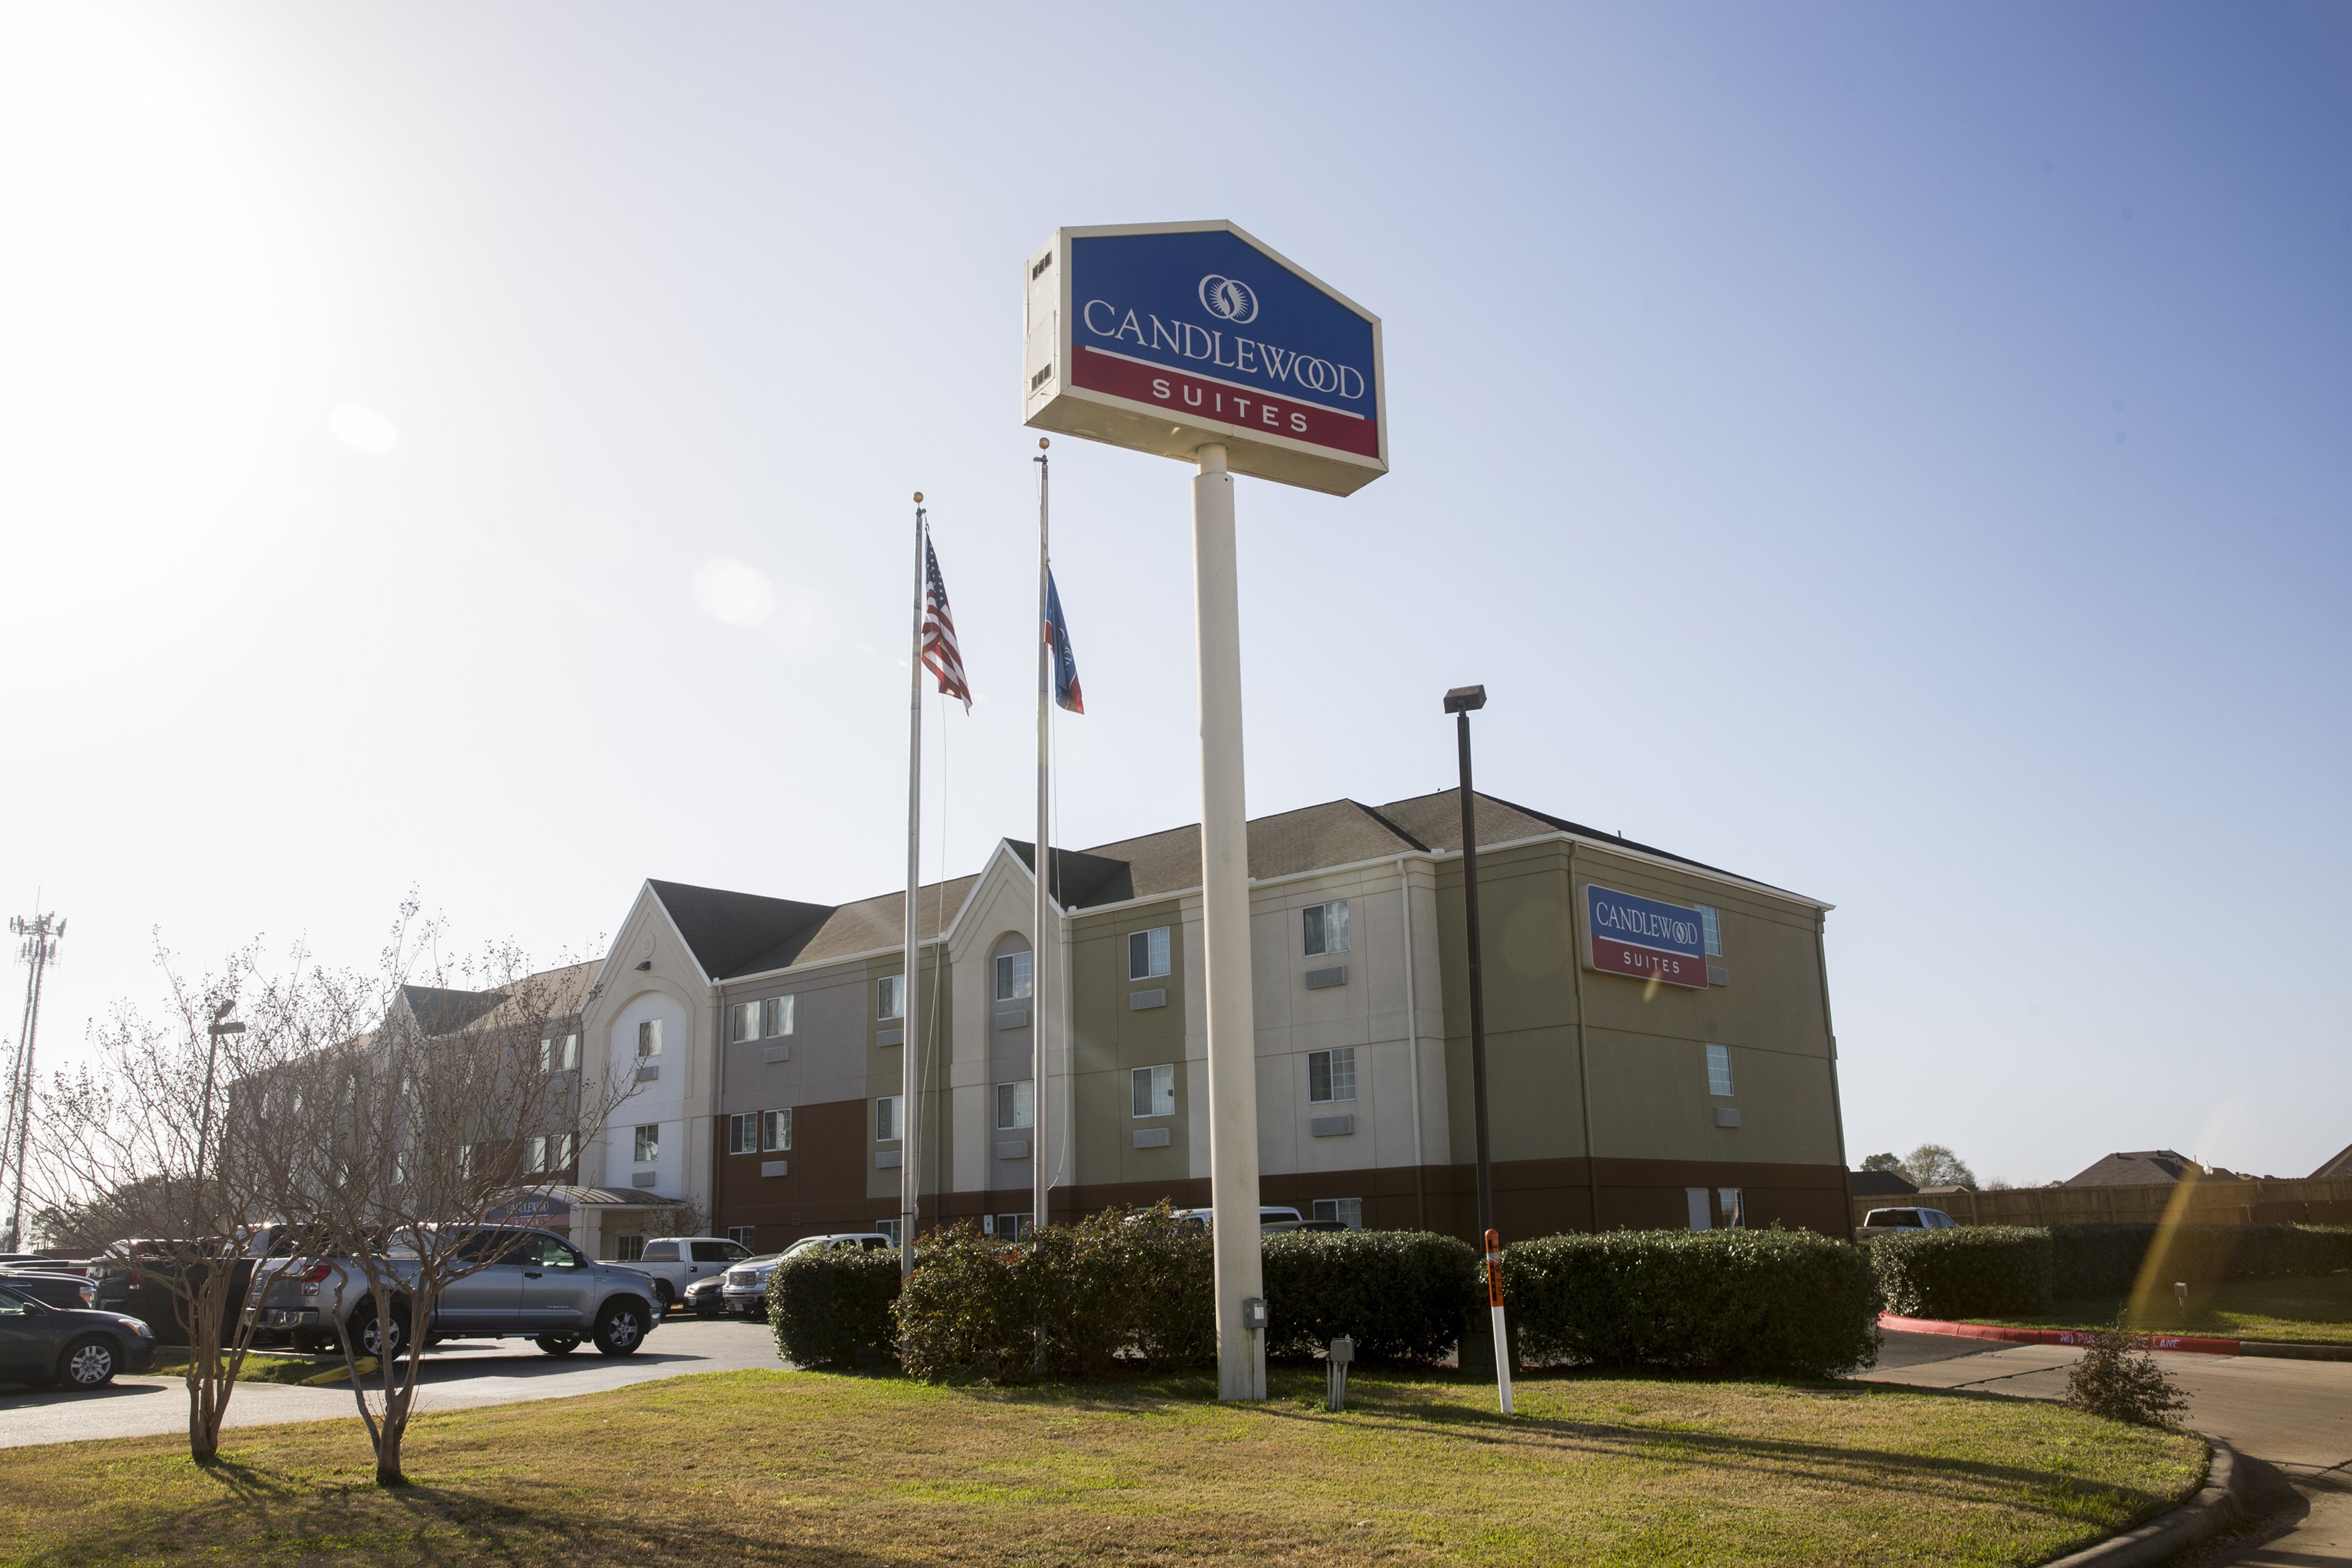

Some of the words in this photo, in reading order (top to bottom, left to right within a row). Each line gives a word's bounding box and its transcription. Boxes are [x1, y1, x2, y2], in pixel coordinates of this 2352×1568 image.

[1084, 299, 1365, 399] CANDLEWOOD
[1152, 378, 1308, 432] SUITES
[1596, 902, 1698, 944] CANDLEWOOD
[1623, 951, 1680, 974] SUITES
[2060, 1333, 2075, 1344] NO
[2152, 1338, 2181, 1348] LANE
